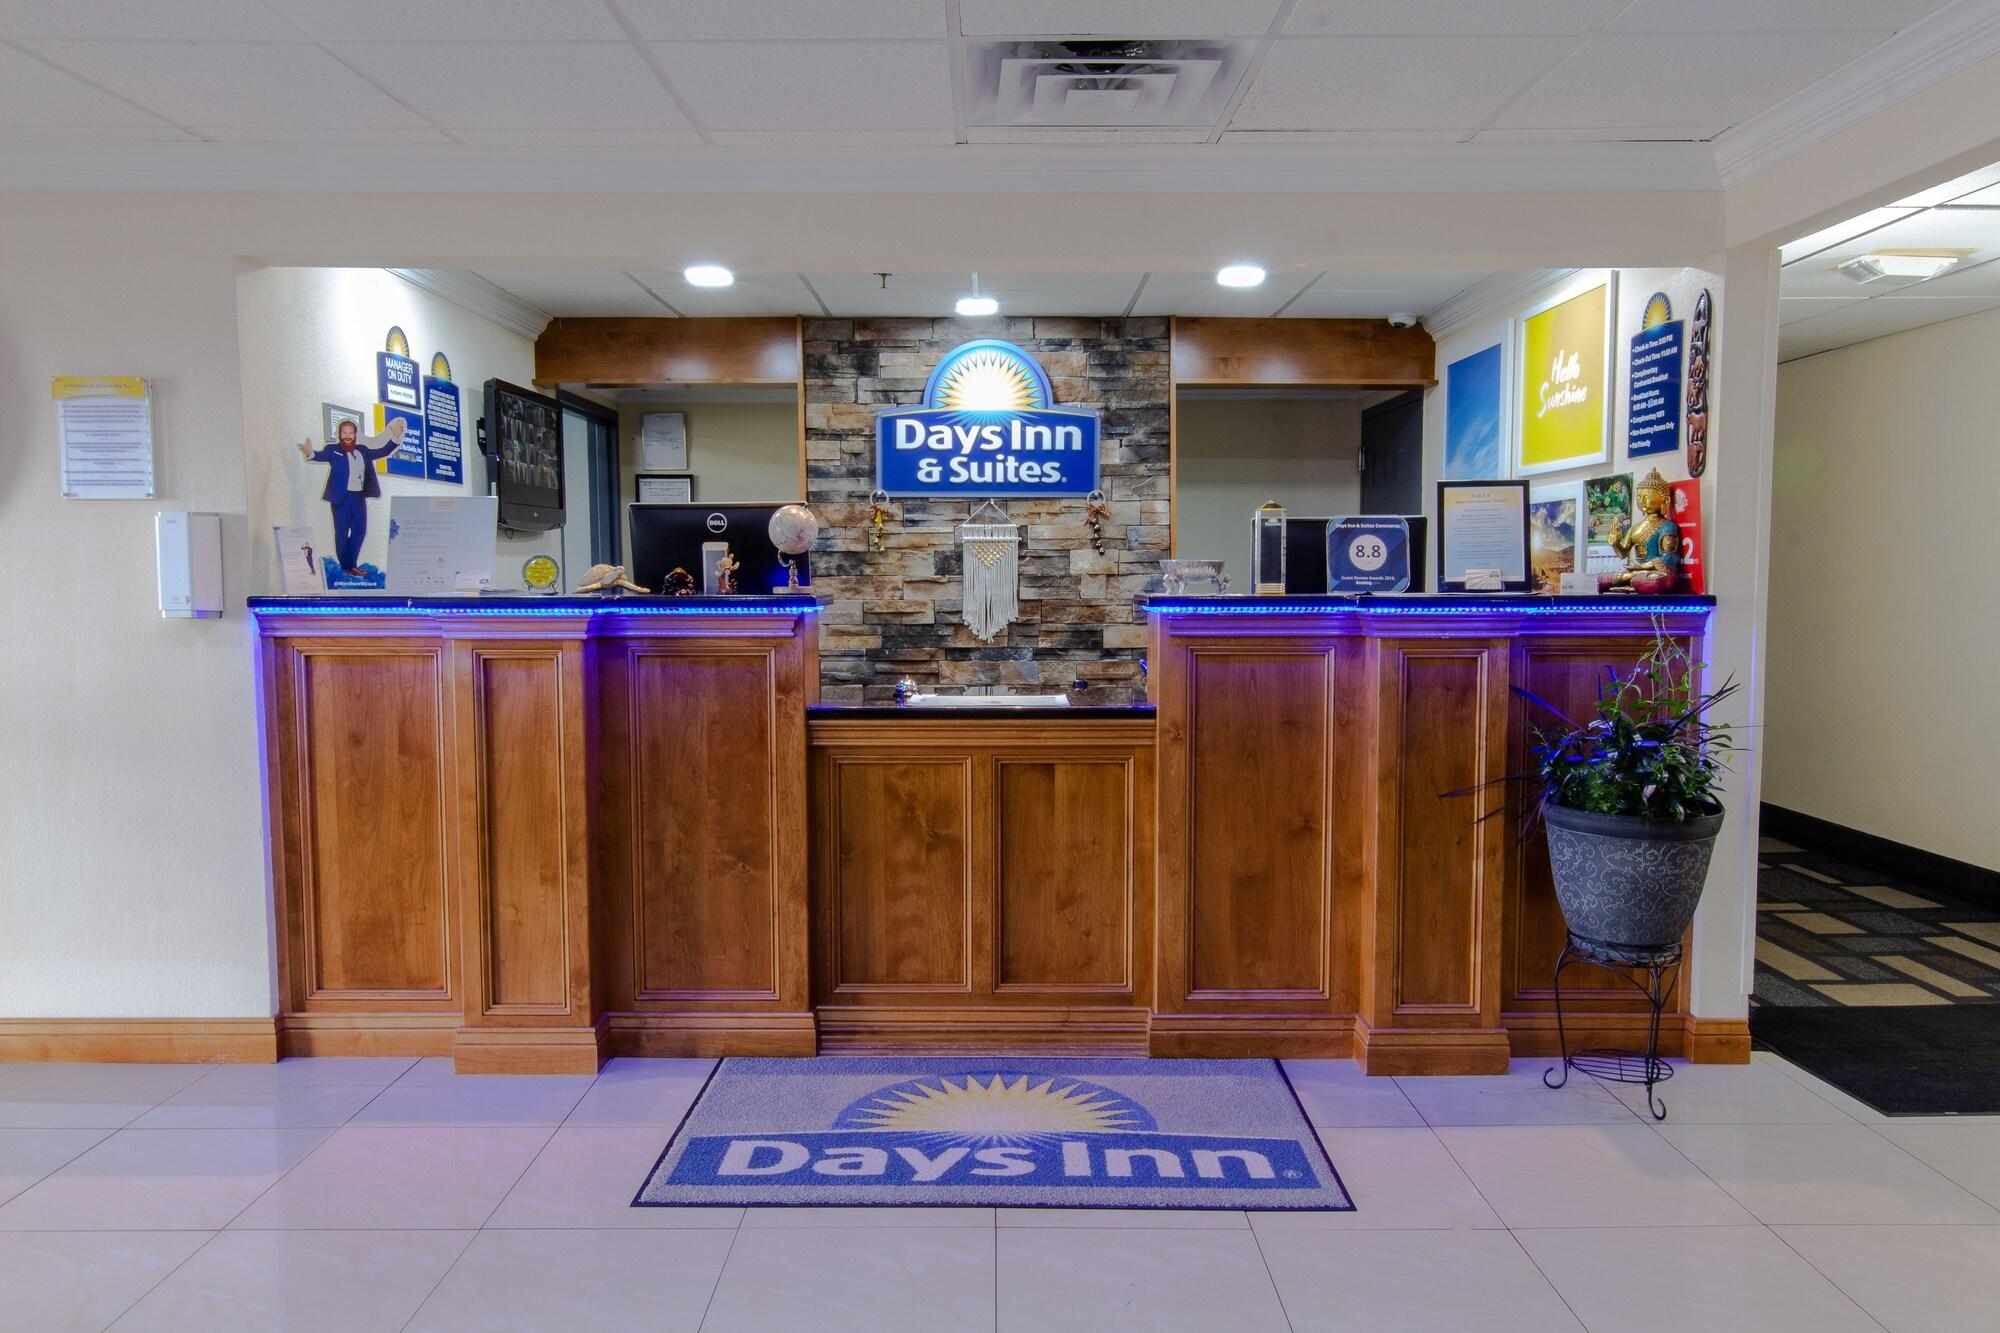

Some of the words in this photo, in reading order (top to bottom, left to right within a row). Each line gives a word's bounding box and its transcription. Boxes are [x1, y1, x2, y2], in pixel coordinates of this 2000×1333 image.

[386, 357, 414, 374] MANAGER
[388, 369, 396, 380] ON
[398, 372, 412, 384] DUTY
[1552, 349, 1580, 385] Hello
[1537, 382, 1588, 418] Sunshine
[896, 418, 1003, 454] Days
[1011, 420, 1082, 450] Inn
[917, 457, 943, 483] &
[950, 454, 1060, 483] Suites
[1356, 544, 1381, 558] 8.8
[717, 1139, 1037, 1182] Days
[1061, 1141, 1276, 1179] Inn
